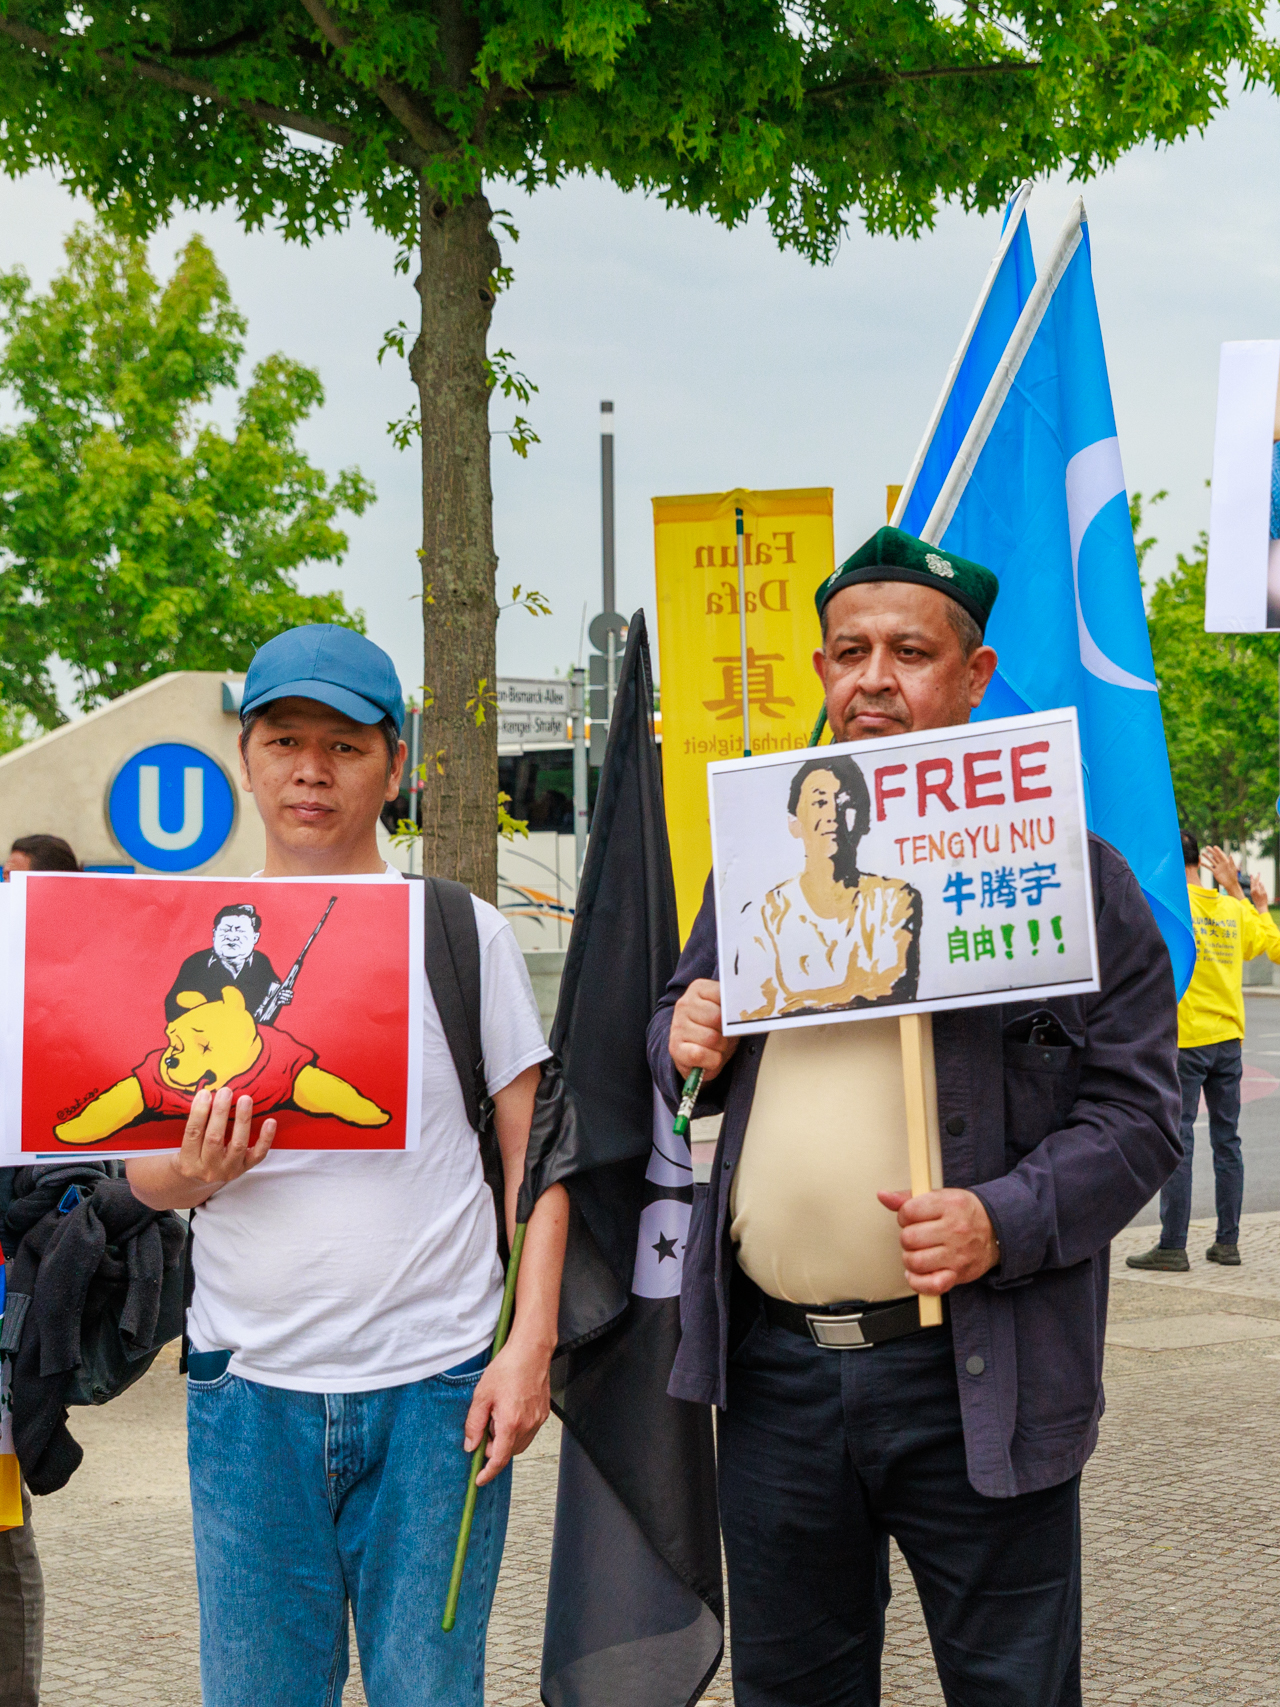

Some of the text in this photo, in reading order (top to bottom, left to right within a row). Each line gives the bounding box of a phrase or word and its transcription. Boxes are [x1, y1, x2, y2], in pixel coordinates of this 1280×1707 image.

[138, 764, 205, 852] U
[874, 740, 1053, 822] FREE
[893, 815, 1056, 866] TENGYU NIU
